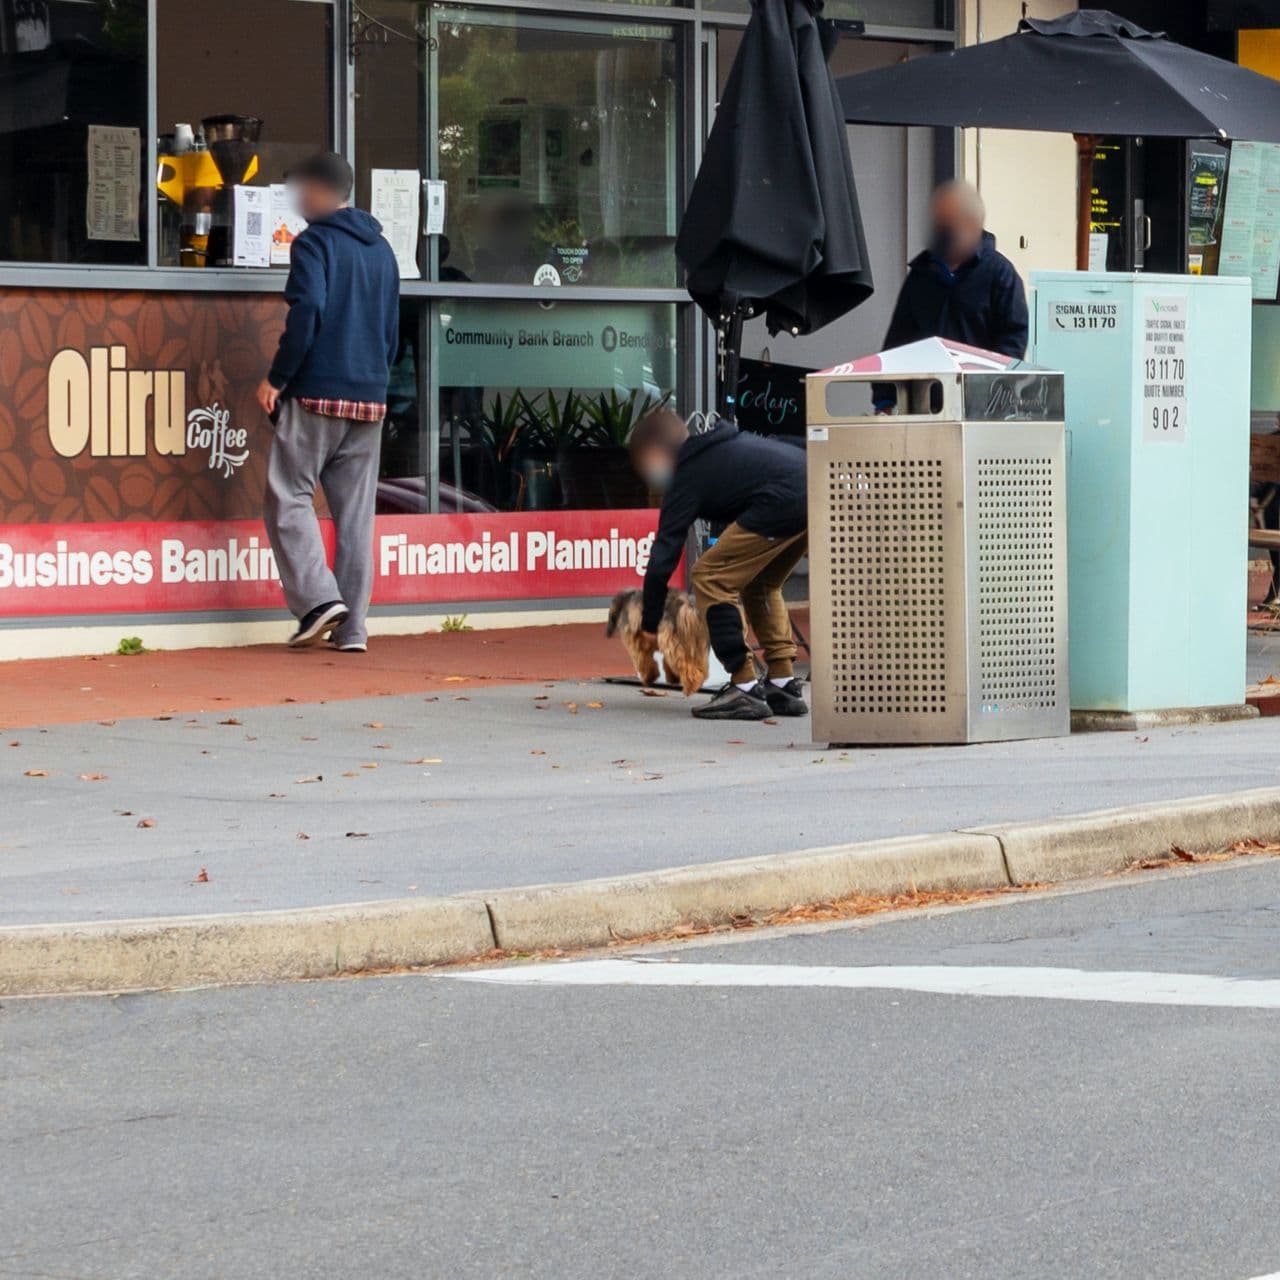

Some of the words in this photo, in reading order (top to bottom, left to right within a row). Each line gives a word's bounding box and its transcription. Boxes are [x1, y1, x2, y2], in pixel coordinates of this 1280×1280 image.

[570, 257, 584, 265] OPEN
[1055, 304, 1085, 315] SIGNAL
[1087, 304, 1117, 315] FAULTS
[1073, 317, 1086, 328] 13
[1088, 317, 1098, 328] 11
[1101, 317, 1116, 329] 70
[446, 326, 514, 350] Community
[518, 329, 549, 347] Bank
[552, 328, 594, 348] Branch
[1145, 358, 1156, 380] 13
[1159, 358, 1169, 380] 11
[1172, 358, 1185, 381] 70
[48, 345, 186, 458] Oliru
[1144, 384, 1161, 398] QUOTE
[1161, 384, 1185, 399] NUMBER
[187, 405, 248, 475] Coffee
[161, 536, 281, 585] Bankin
[379, 531, 520, 577] Financial
[526, 527, 657, 577] Planning
